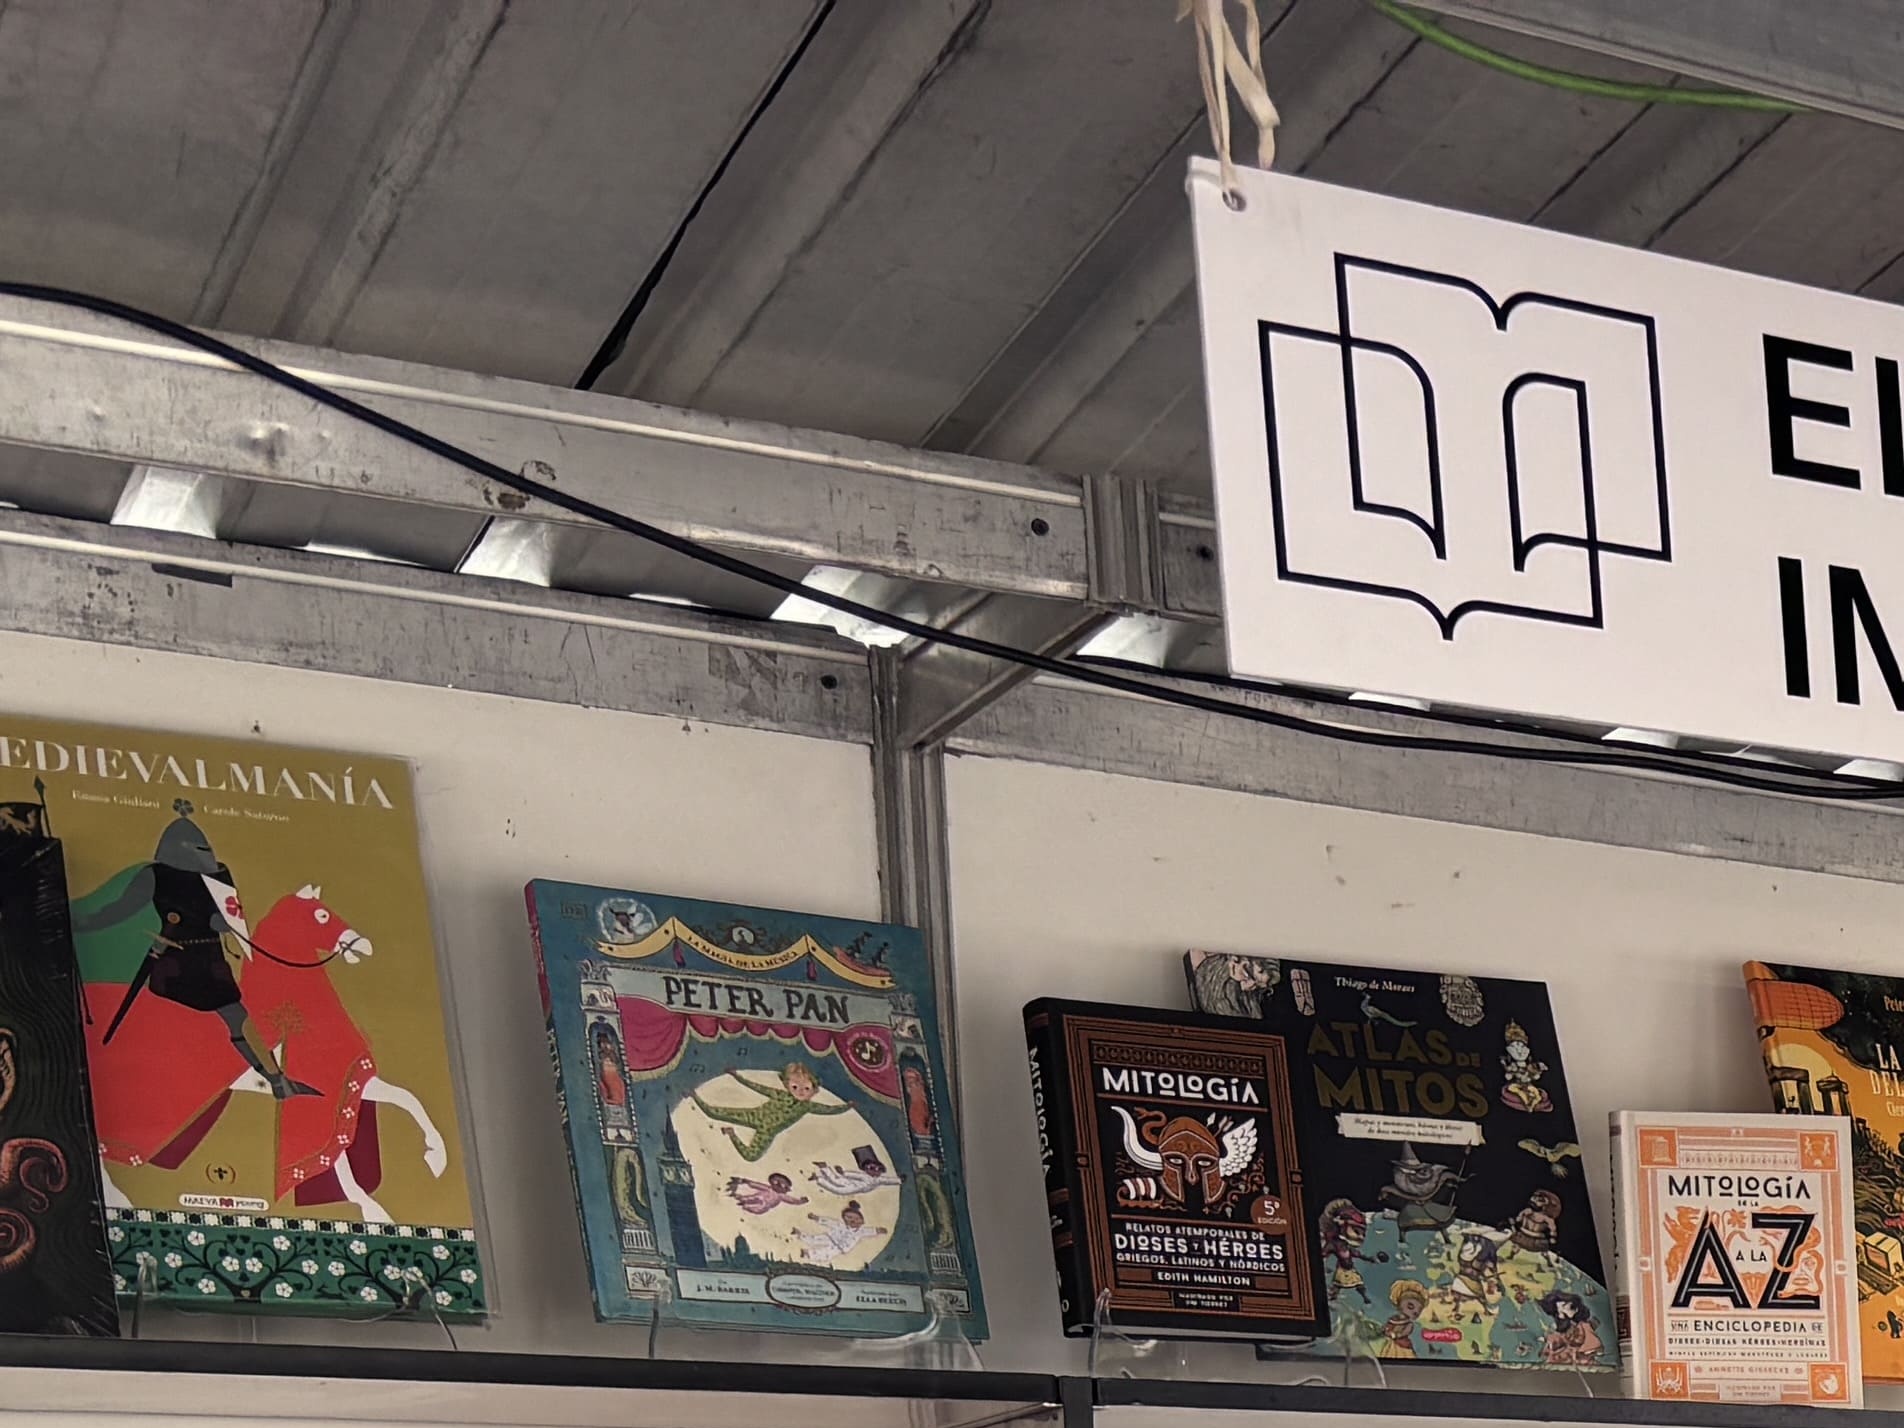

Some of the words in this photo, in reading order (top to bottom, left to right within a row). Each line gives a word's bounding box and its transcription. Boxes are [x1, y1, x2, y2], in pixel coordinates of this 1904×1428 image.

[0, 736, 394, 809] EDIEVALMANÍA
[664, 975, 770, 1018] PETER
[785, 988, 852, 1025] PAN
[1103, 1067, 1259, 1104] MITOLOGÍA
[1668, 1174, 1811, 1200] MITOLOGÍA
[1115, 1232, 1189, 1254] DIOSES
[1203, 1236, 1283, 1260] HÉROES
[1694, 1318, 1807, 1334] ENCICLOPEDIA
